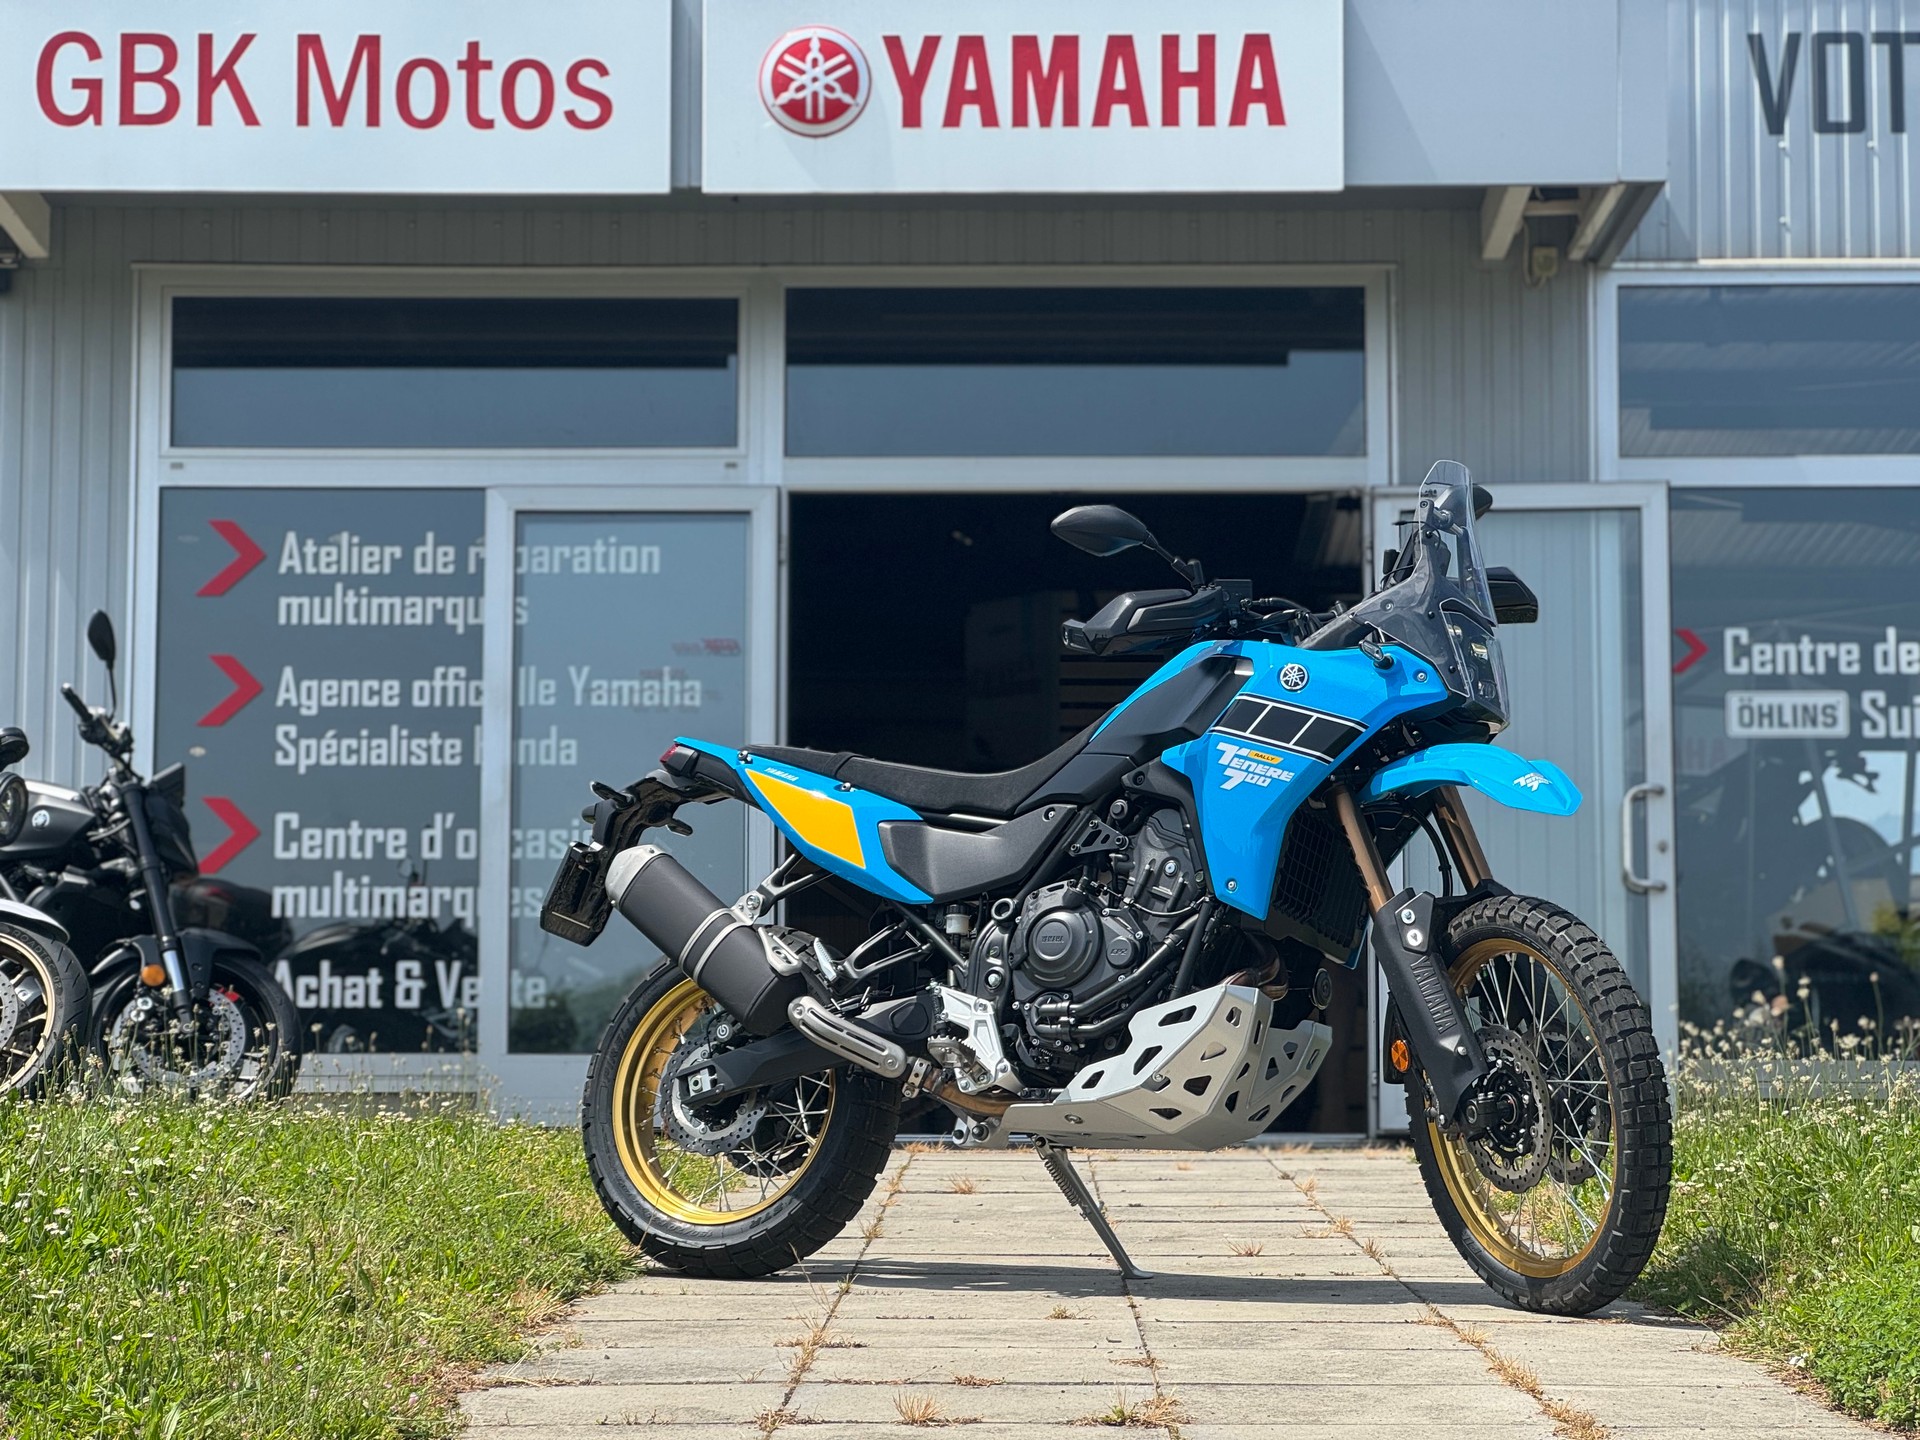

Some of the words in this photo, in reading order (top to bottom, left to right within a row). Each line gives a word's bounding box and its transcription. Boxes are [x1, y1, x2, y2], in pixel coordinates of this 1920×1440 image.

[35, 31, 261, 127] GBK
[296, 33, 614, 130] Motos
[882, 33, 1287, 128] YAMAHA
[1747, 32, 1920, 135] VOT
[278, 531, 402, 574] Atelier
[414, 531, 456, 574] de
[468, 536, 660, 574] raration
[278, 581, 529, 634] multimarqus
[1723, 627, 1860, 674] Centre
[1874, 626, 1920, 674] de
[275, 666, 400, 715] Agence
[412, 666, 556, 707] officlle
[568, 665, 701, 707] Yamaha
[1737, 696, 1838, 729] ÖHLINS
[275, 724, 462, 775] Spécialiste
[474, 725, 577, 766] nda
[1254, 753, 1276, 762] RALLY
[1220, 767, 1272, 791] 700
[274, 812, 407, 859] Centre
[271, 870, 544, 929] multimarqs
[274, 959, 383, 1008] Achat
[395, 960, 426, 1008] &
[1410, 955, 1458, 1035] YAMAHA
